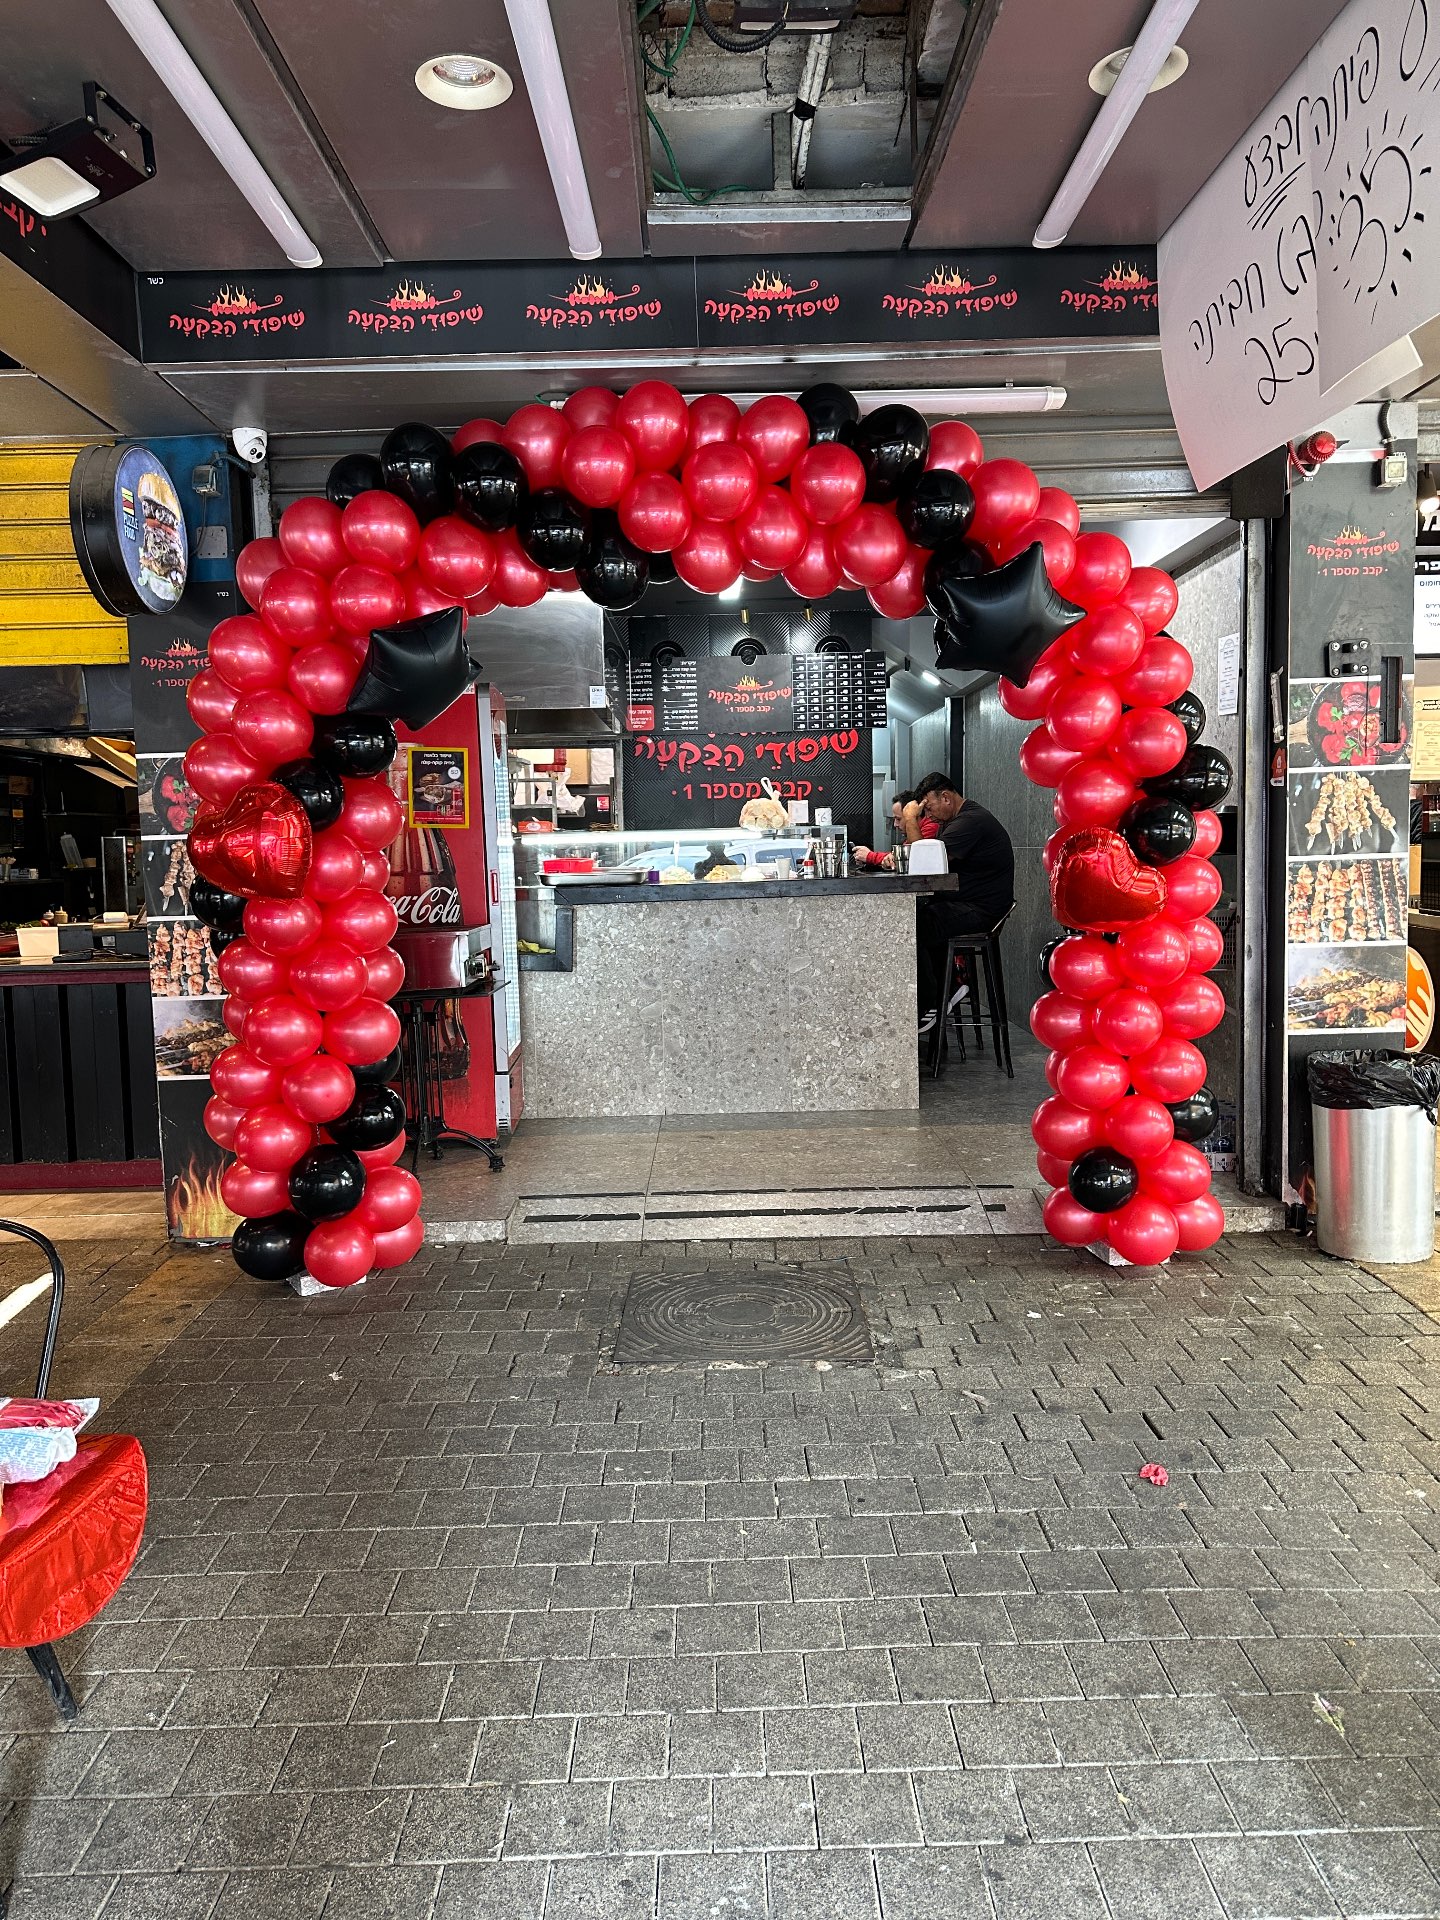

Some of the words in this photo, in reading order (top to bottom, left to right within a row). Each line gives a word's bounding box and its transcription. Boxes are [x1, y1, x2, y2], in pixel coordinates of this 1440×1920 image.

[147, 277, 164, 285] כשר
[1244, 316, 1316, 406] 25
[1322, 568, 1328, 576] 1
[1330, 566, 1359, 576] מספר
[1362, 566, 1383, 577] קבב
[157, 679, 162, 687] 1
[756, 705, 771, 713] קבב
[683, 784, 693, 800] 1
[700, 782, 761, 799] מספר
